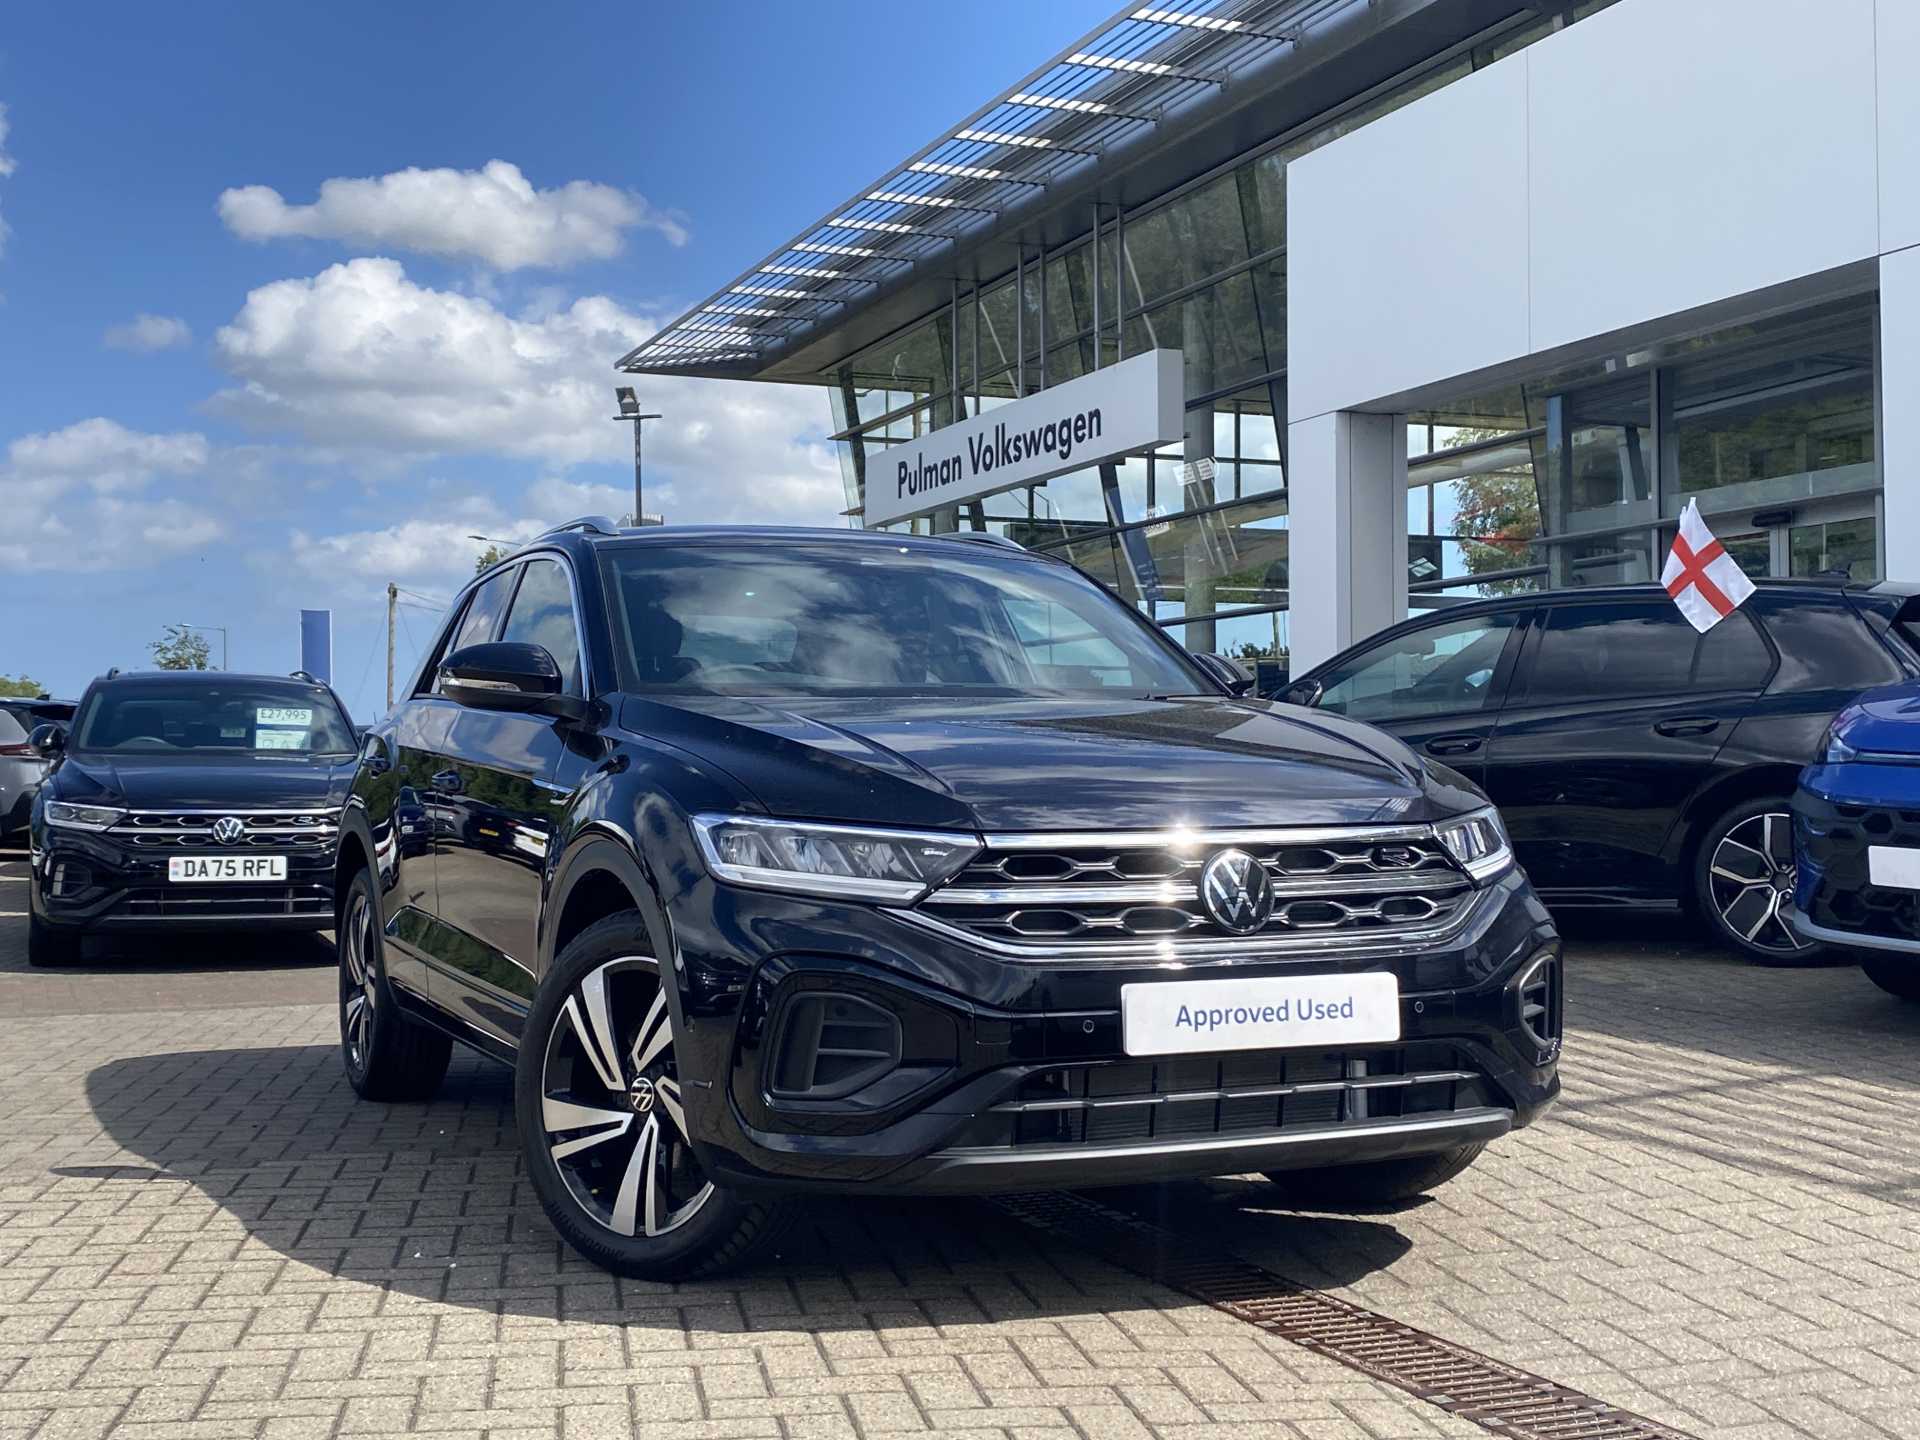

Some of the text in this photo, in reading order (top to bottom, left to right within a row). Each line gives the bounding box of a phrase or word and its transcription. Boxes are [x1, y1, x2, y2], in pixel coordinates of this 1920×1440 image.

[898, 408, 1101, 499] Pulman Volkswagen
[184, 859, 281, 877] DA75 RFL
[1175, 996, 1353, 1032] Approved Used
